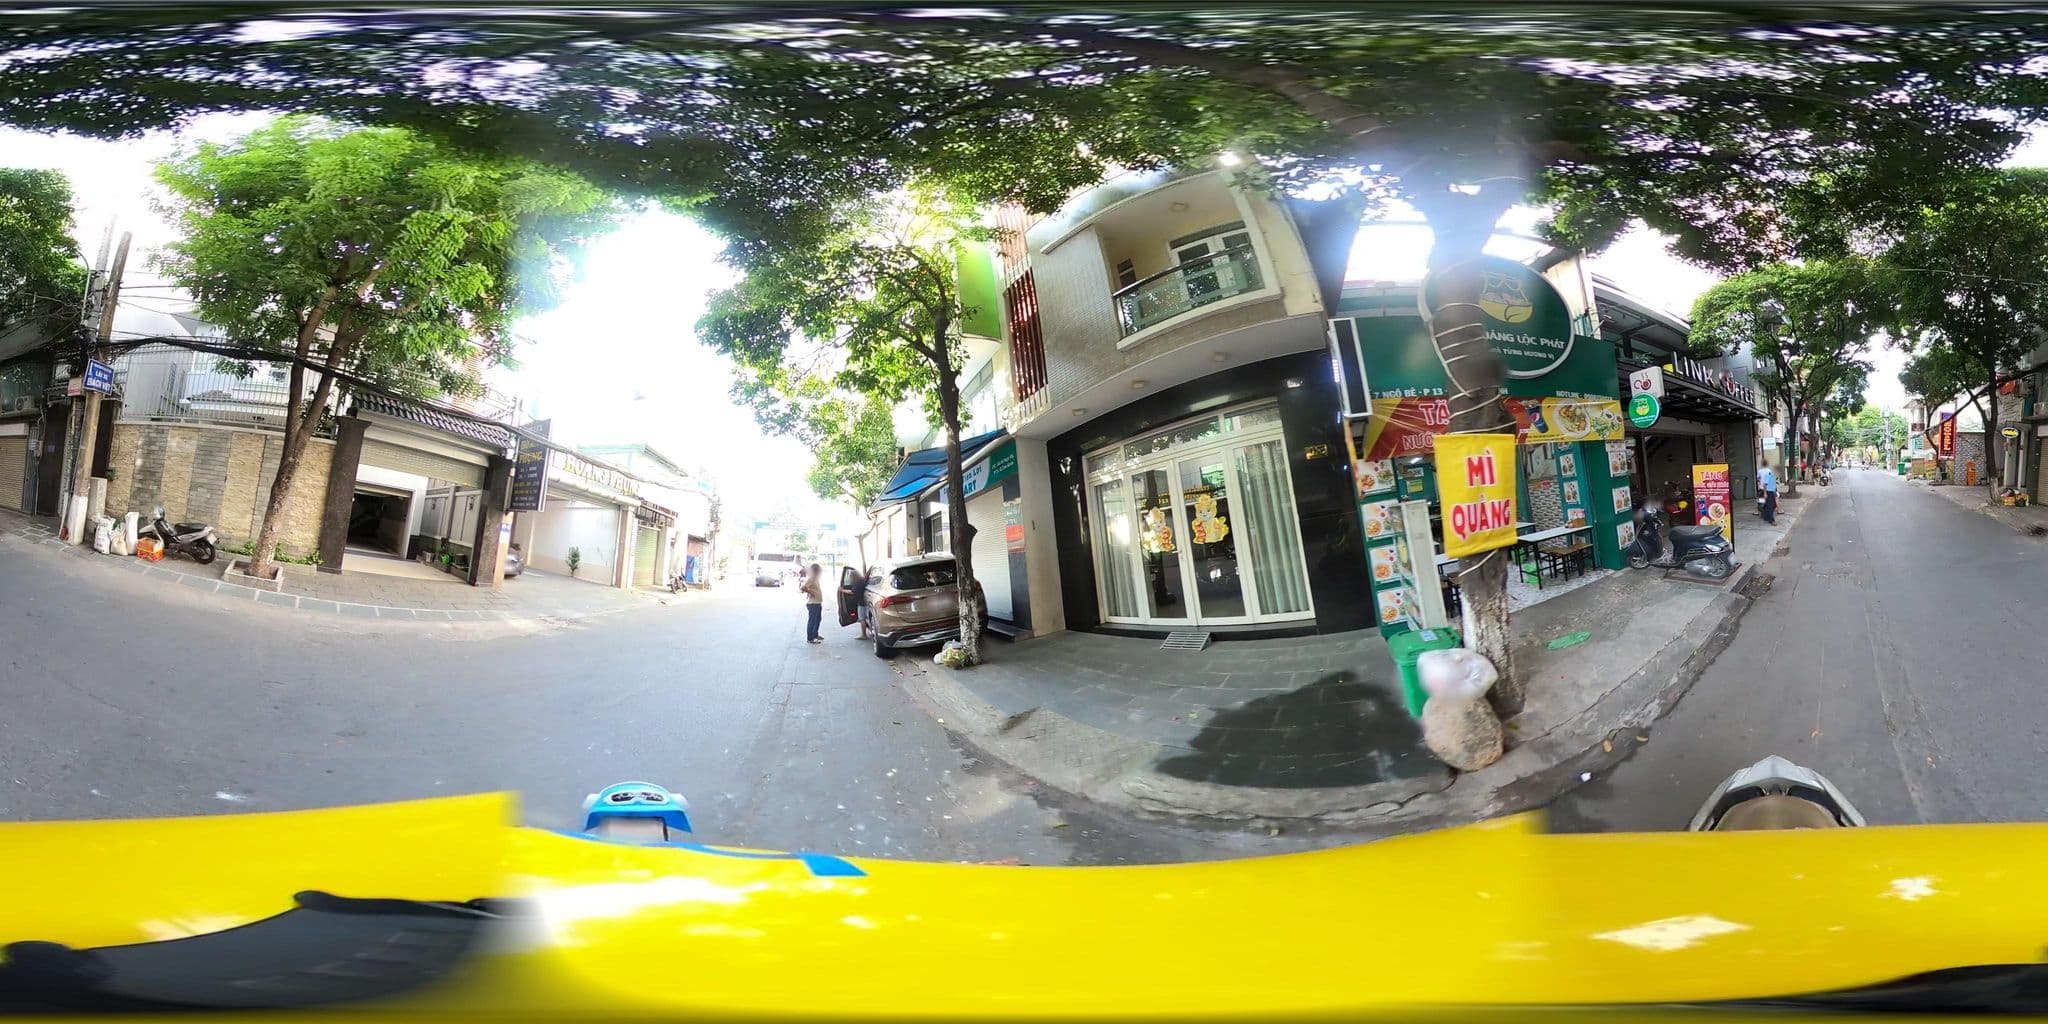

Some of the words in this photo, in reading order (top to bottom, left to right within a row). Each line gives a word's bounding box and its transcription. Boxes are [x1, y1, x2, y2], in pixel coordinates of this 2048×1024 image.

[1674, 351, 1714, 386] LINK
[1419, 399, 1451, 426] TẶ
[1402, 431, 1435, 450] NƯỚ
[1466, 448, 1496, 488] MÌ
[1451, 494, 1512, 540] QUẢNG
